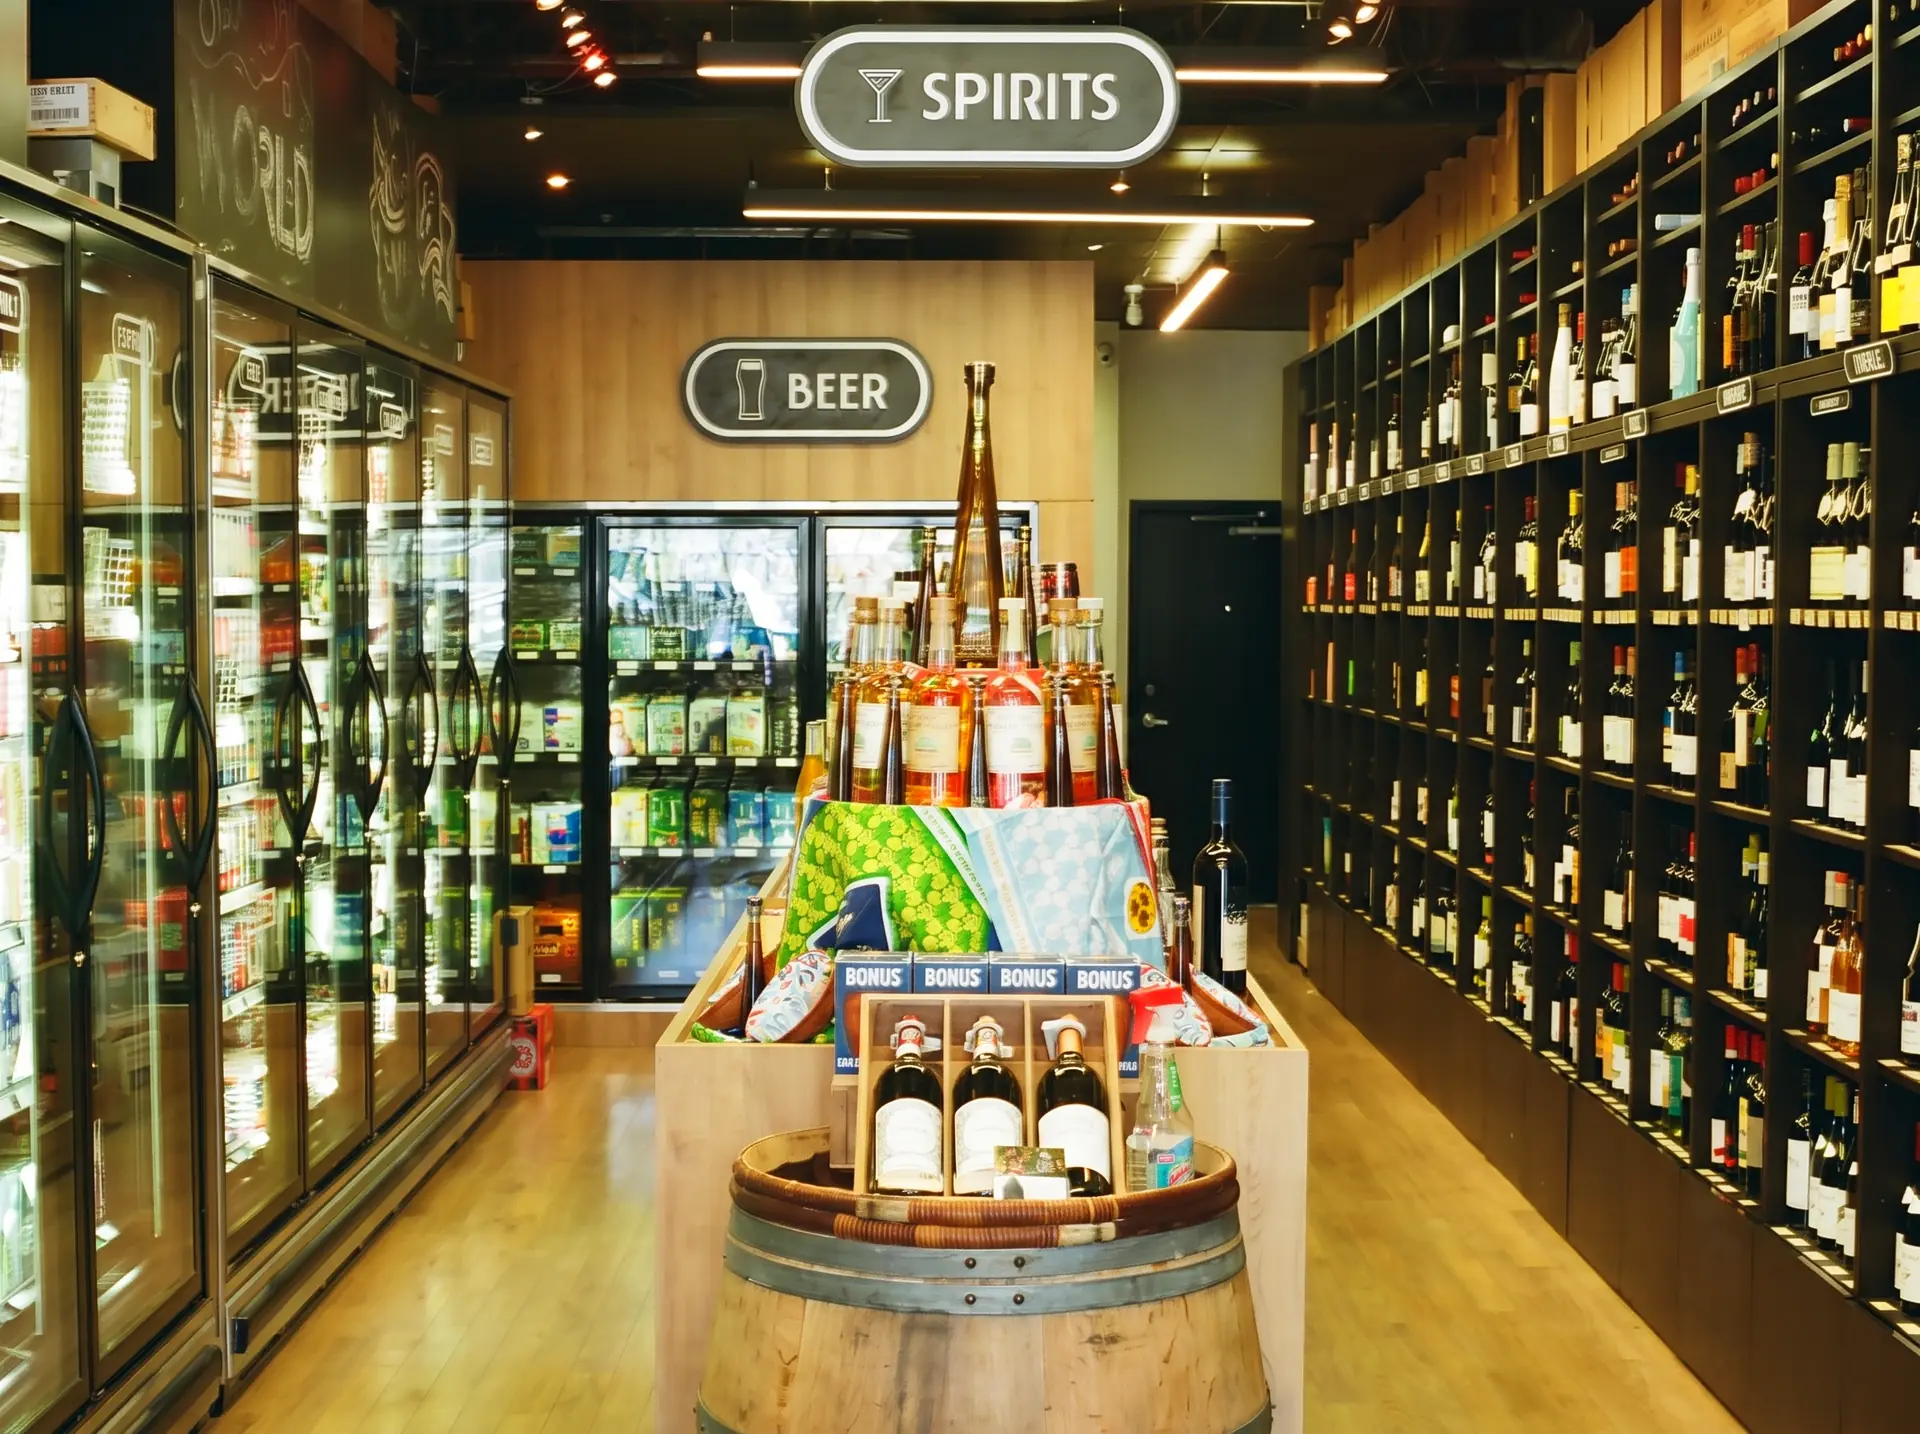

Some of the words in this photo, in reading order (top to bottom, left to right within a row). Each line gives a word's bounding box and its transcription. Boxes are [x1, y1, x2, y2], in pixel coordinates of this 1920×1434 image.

[922, 72, 1119, 121] SPIRITS
[190, 84, 315, 260] WORLD
[788, 373, 888, 410] BEER
[845, 966, 903, 987] BONUS
[925, 967, 982, 988] BONUS
[1000, 967, 1057, 988] BONUS
[1077, 969, 1134, 990] BONUS
